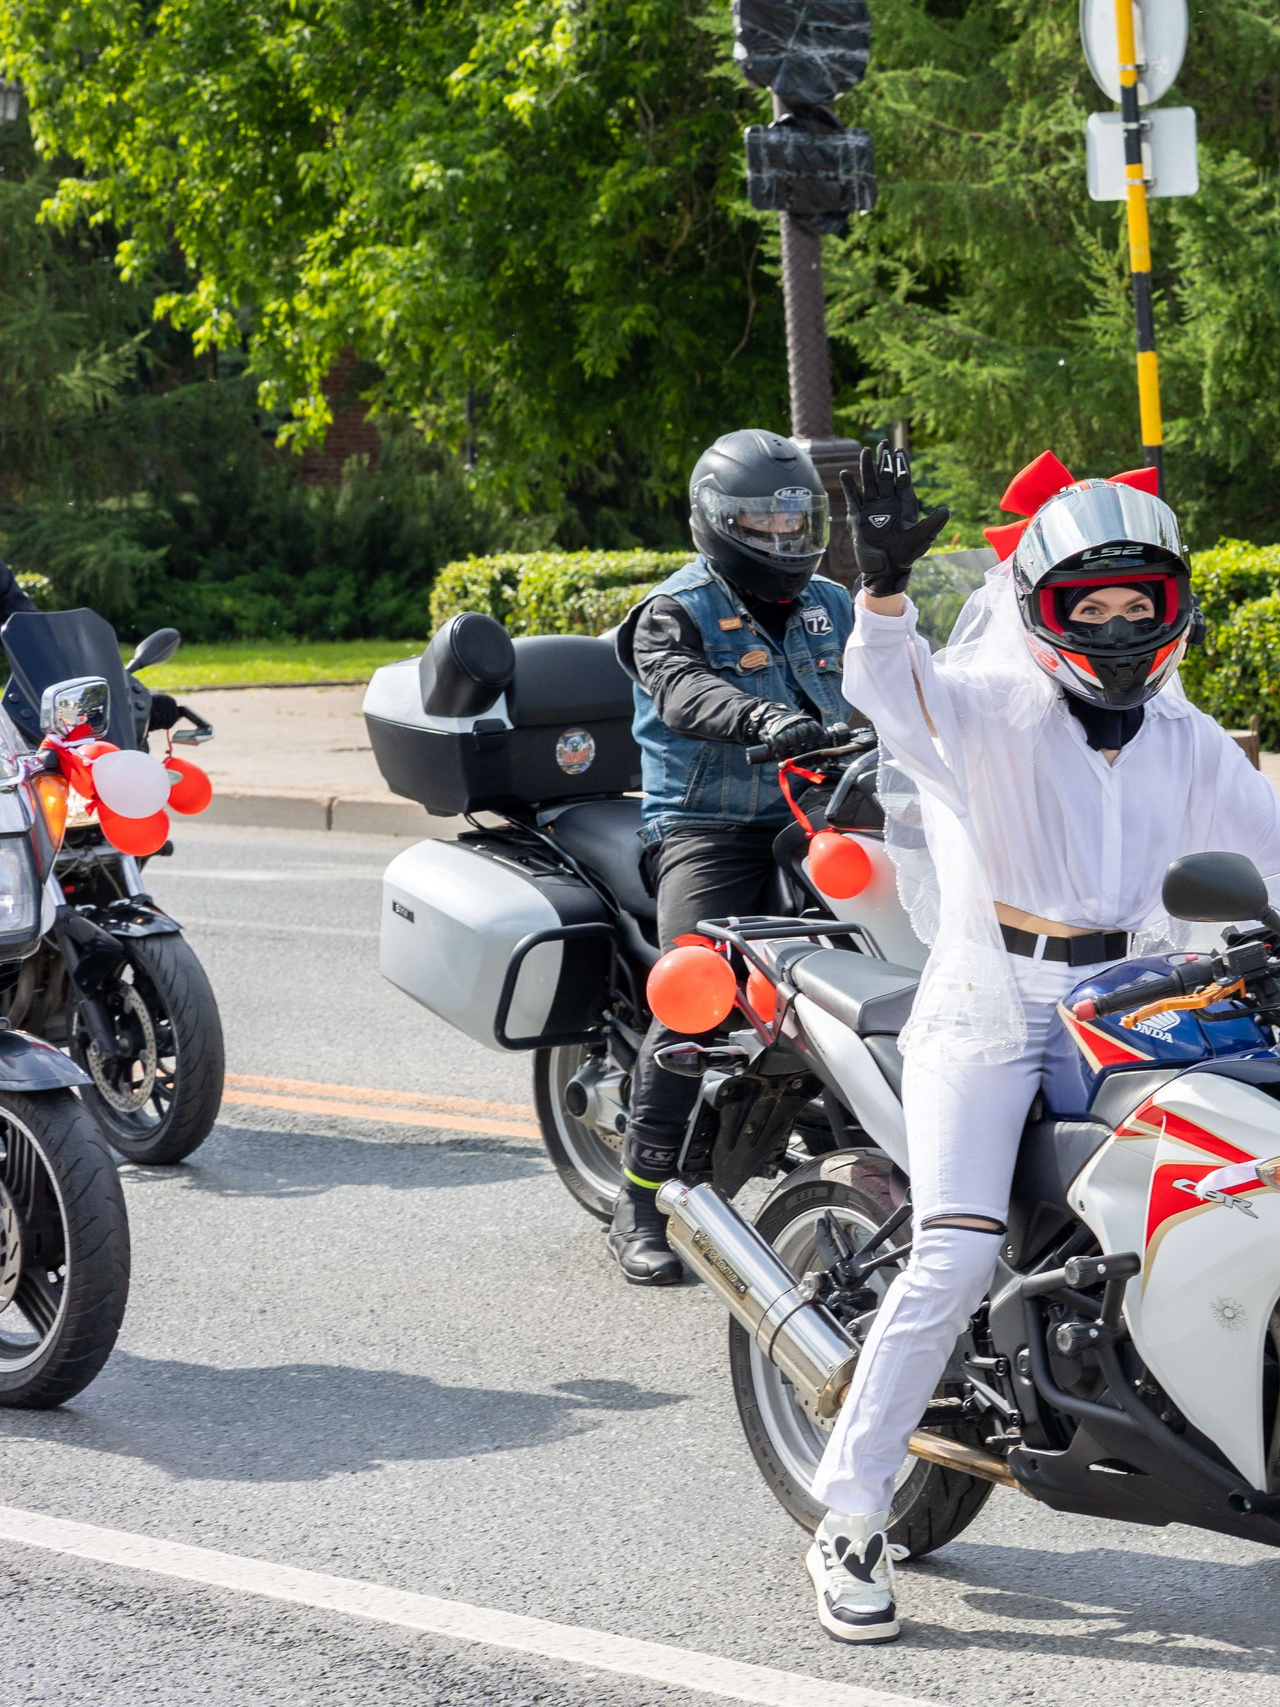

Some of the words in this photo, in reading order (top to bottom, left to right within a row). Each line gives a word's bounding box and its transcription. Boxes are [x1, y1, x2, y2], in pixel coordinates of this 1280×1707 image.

[780, 488, 810, 498] HJC
[1081, 545, 1144, 560] LS2
[806, 616, 832, 633] 72
[1118, 1018, 1174, 1043] ONDA
[640, 1149, 677, 1162] LS2
